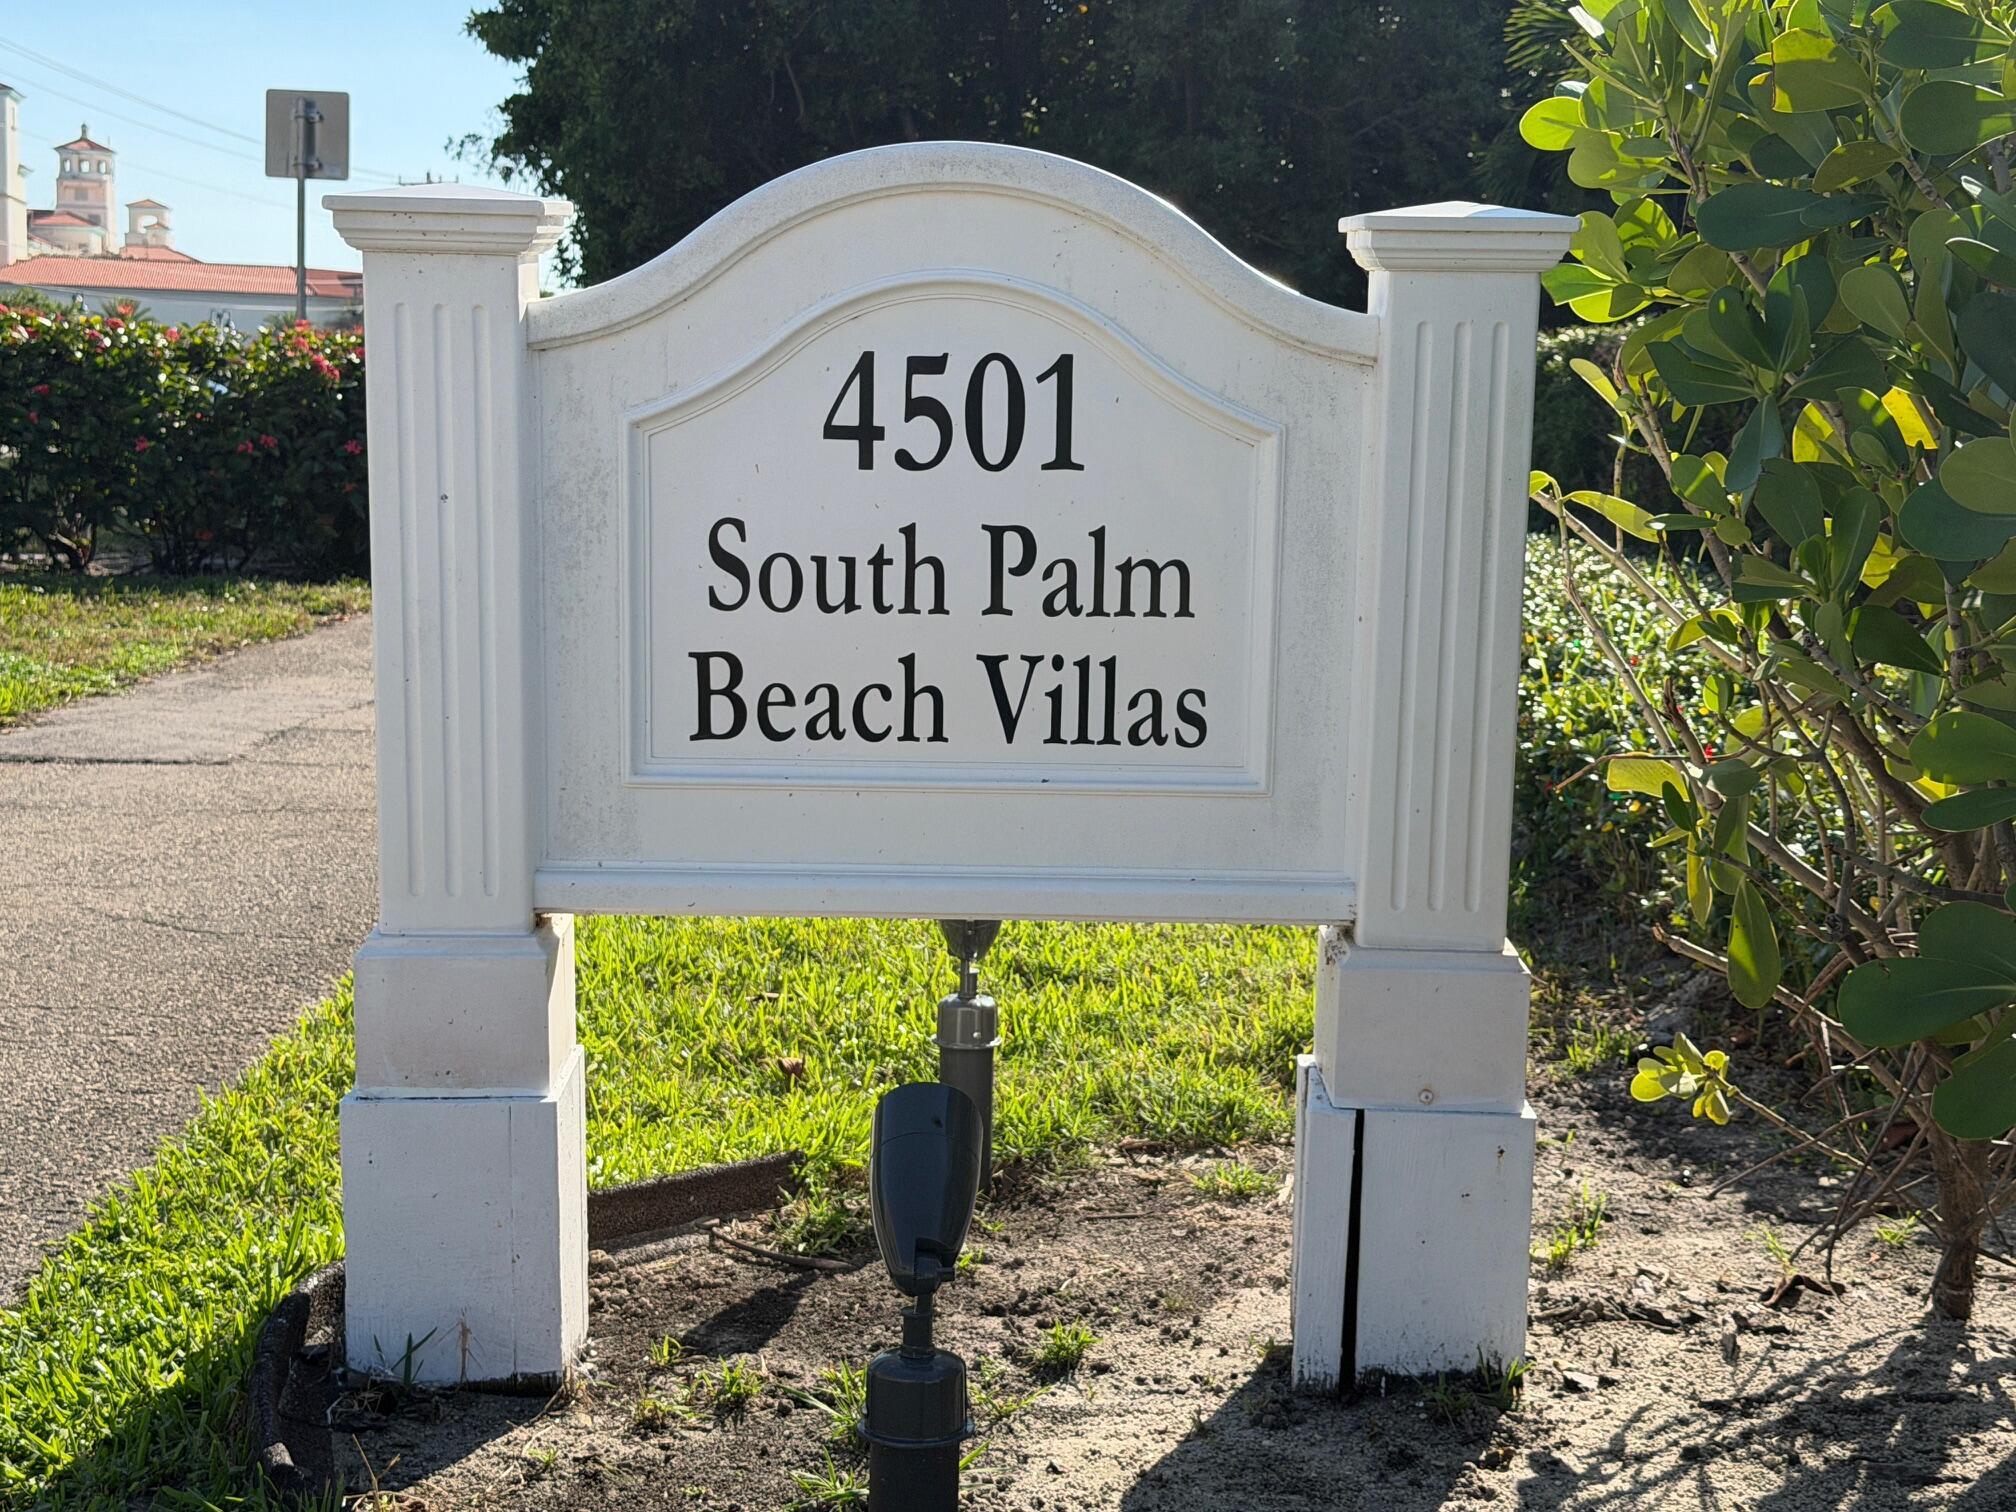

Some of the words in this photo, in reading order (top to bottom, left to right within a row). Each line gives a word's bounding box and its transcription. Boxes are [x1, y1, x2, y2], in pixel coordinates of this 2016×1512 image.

[822, 351, 1085, 472] 4501
[708, 518, 950, 616] South
[981, 523, 1195, 618] Palm
[687, 651, 949, 744] Beach
[975, 653, 1208, 748] Villas
